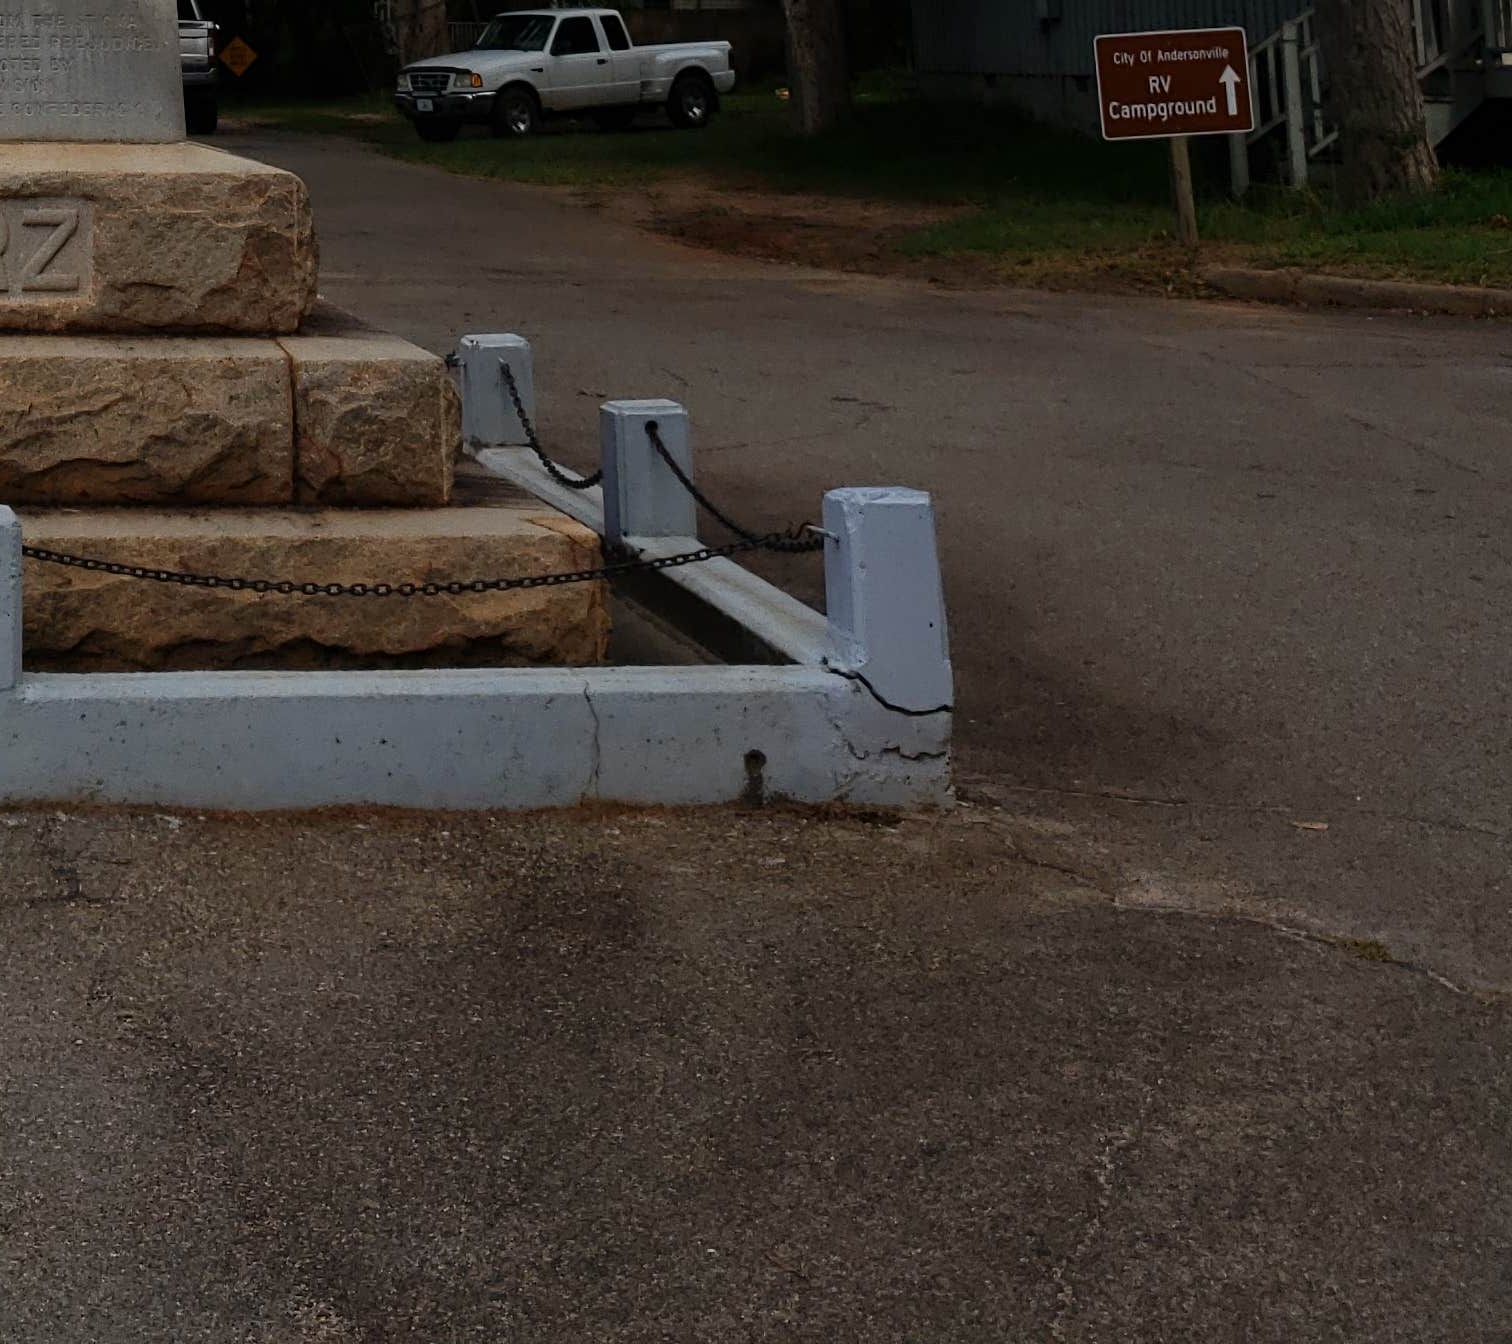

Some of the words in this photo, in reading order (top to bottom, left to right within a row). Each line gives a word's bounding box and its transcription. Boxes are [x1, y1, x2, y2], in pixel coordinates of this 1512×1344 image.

[1113, 51, 1135, 66] City
[1140, 50, 1153, 63] Of
[1157, 46, 1230, 62] Andersonville
[1148, 75, 1172, 95] RV
[1108, 97, 1217, 122] Campground
